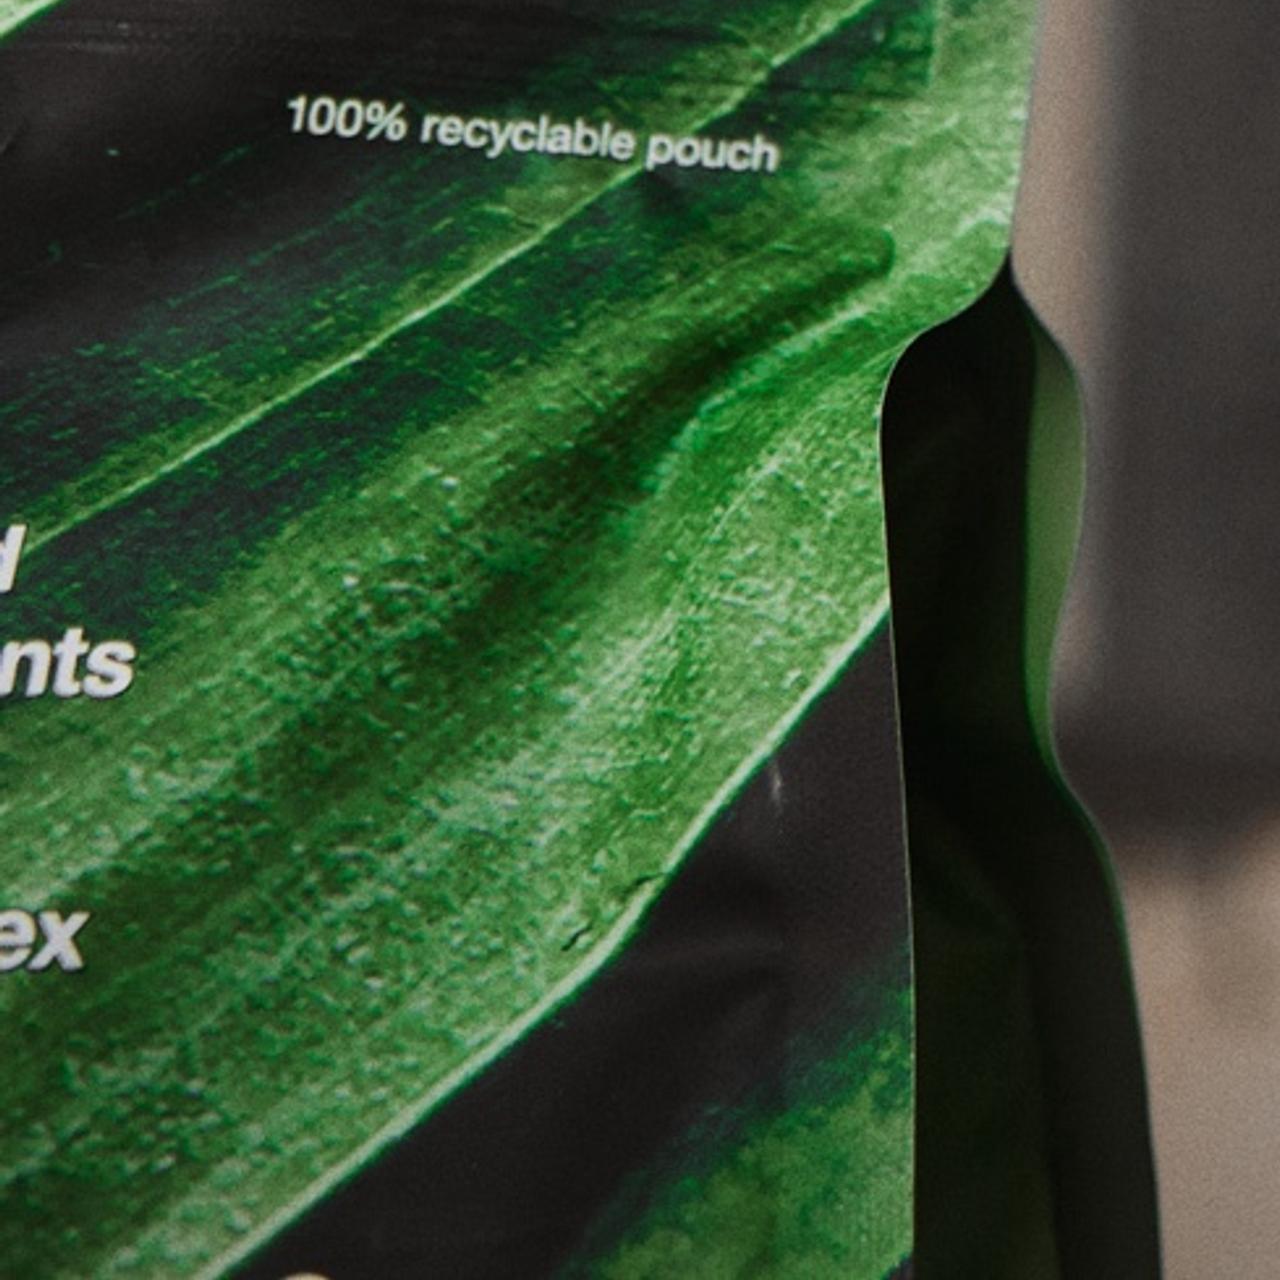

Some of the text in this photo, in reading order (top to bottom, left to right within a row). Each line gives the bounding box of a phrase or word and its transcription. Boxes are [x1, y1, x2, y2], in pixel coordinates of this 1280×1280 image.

[287, 94, 780, 172] 100% recyclable pouch
